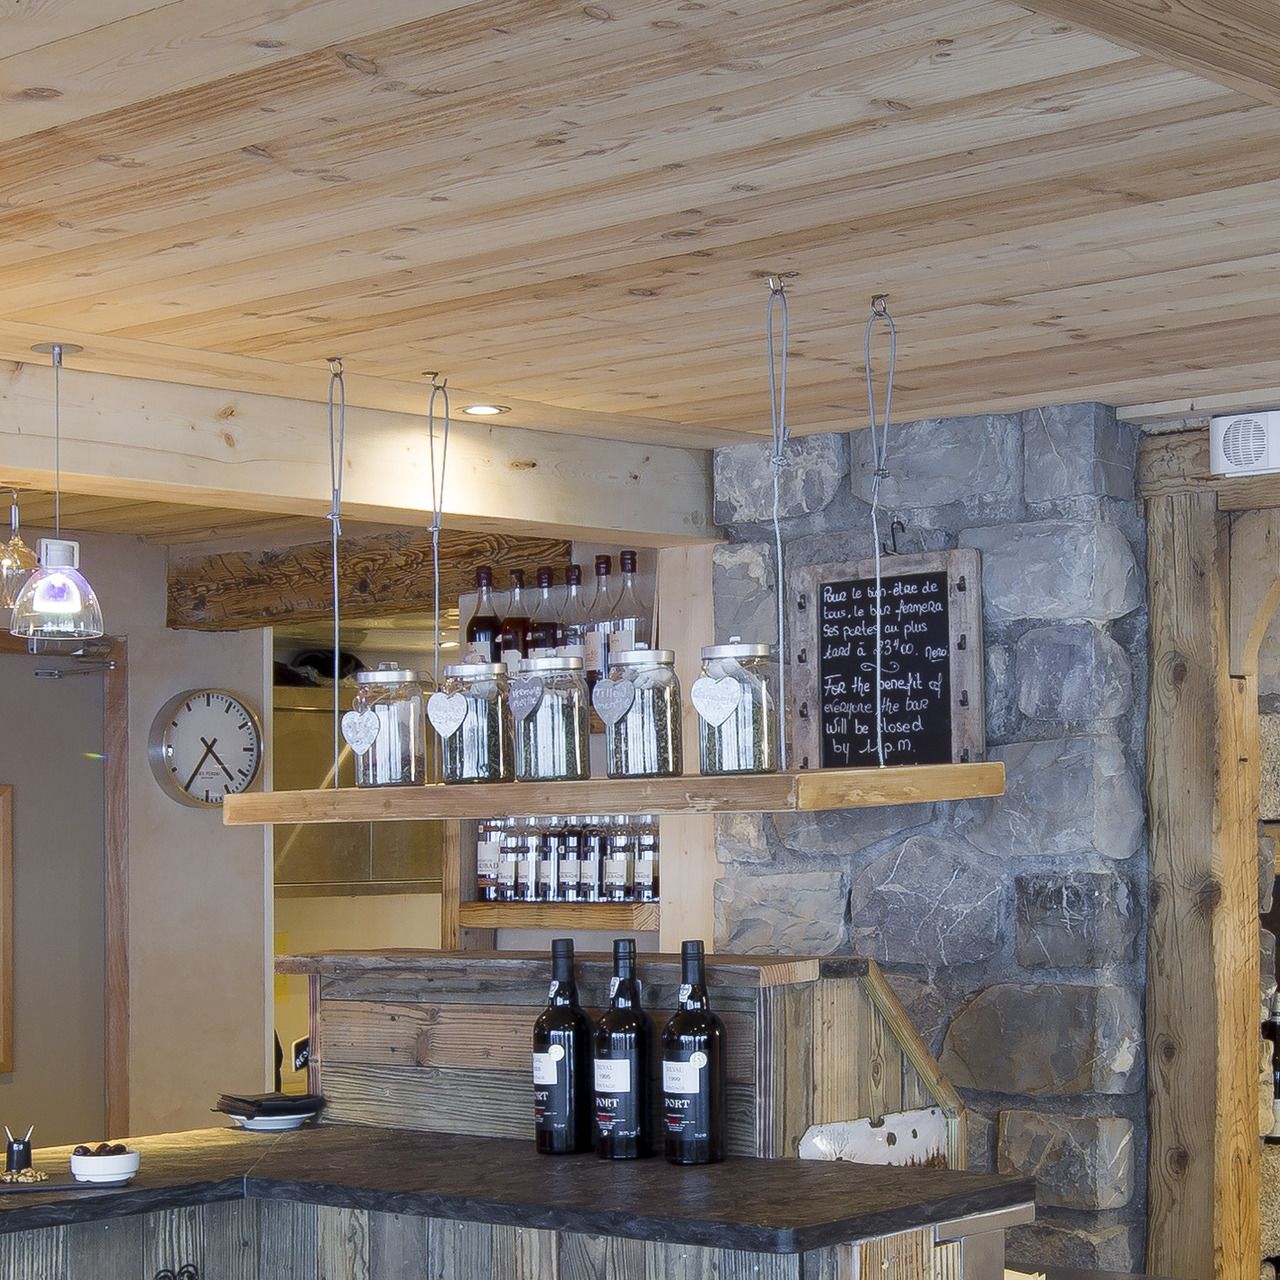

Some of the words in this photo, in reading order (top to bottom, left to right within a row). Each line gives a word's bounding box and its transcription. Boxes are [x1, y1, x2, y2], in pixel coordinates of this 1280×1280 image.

[852, 587, 862, 599] le
[922, 580, 939, 594] de
[854, 605, 864, 617] le
[884, 624, 899, 634] au
[904, 620, 928, 640] plus
[823, 642, 851, 659] tard
[851, 676, 870, 697] the
[928, 672, 943, 699] of
[881, 697, 900, 715] the
[906, 697, 929, 712] bar
[854, 718, 869, 735] be
[832, 738, 849, 764] by
[595, 1097, 620, 1108] PORT
[664, 1098, 690, 1109] PORT
